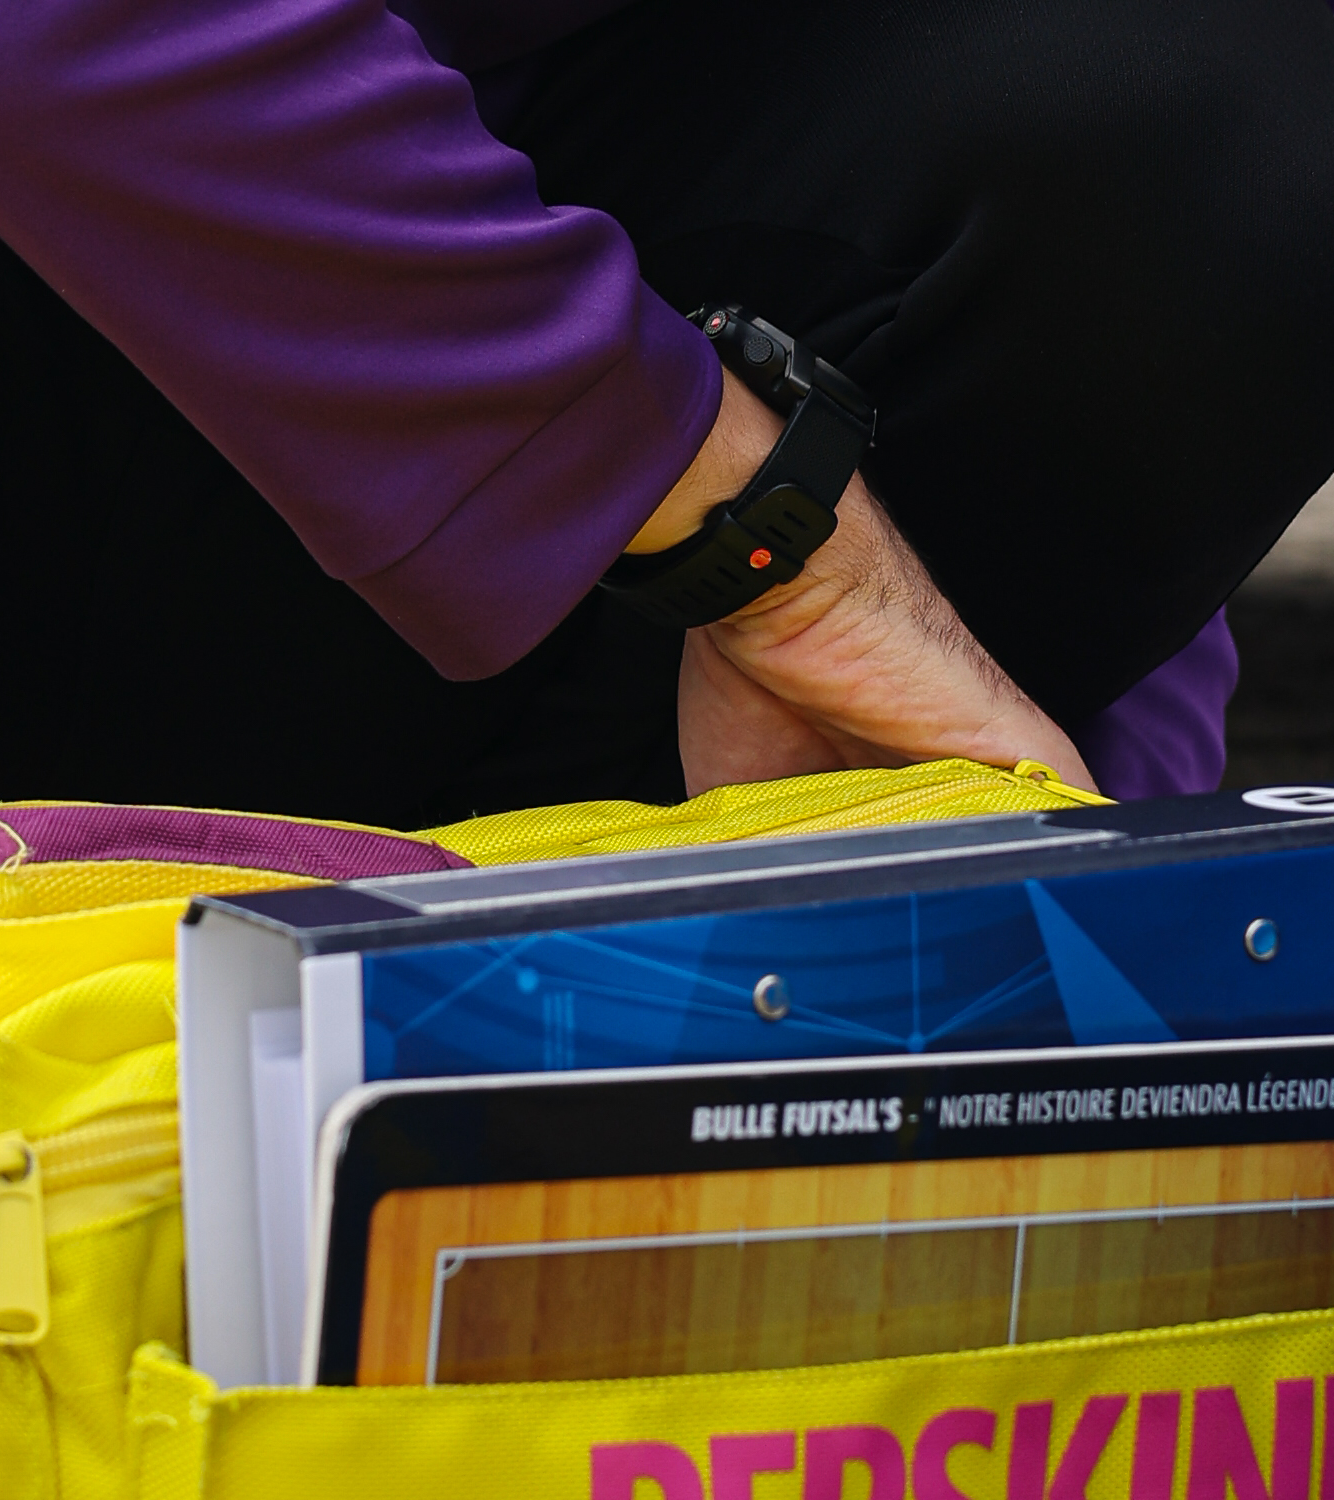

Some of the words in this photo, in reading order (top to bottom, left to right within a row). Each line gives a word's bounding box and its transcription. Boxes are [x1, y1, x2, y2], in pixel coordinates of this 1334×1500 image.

[691, 1103, 777, 1142] BULLE
[782, 1097, 903, 1138] FUTSAL'S
[1017, 1087, 1116, 1125] HISTOIRE
[1121, 1082, 1242, 1120] DEVIENDRA
